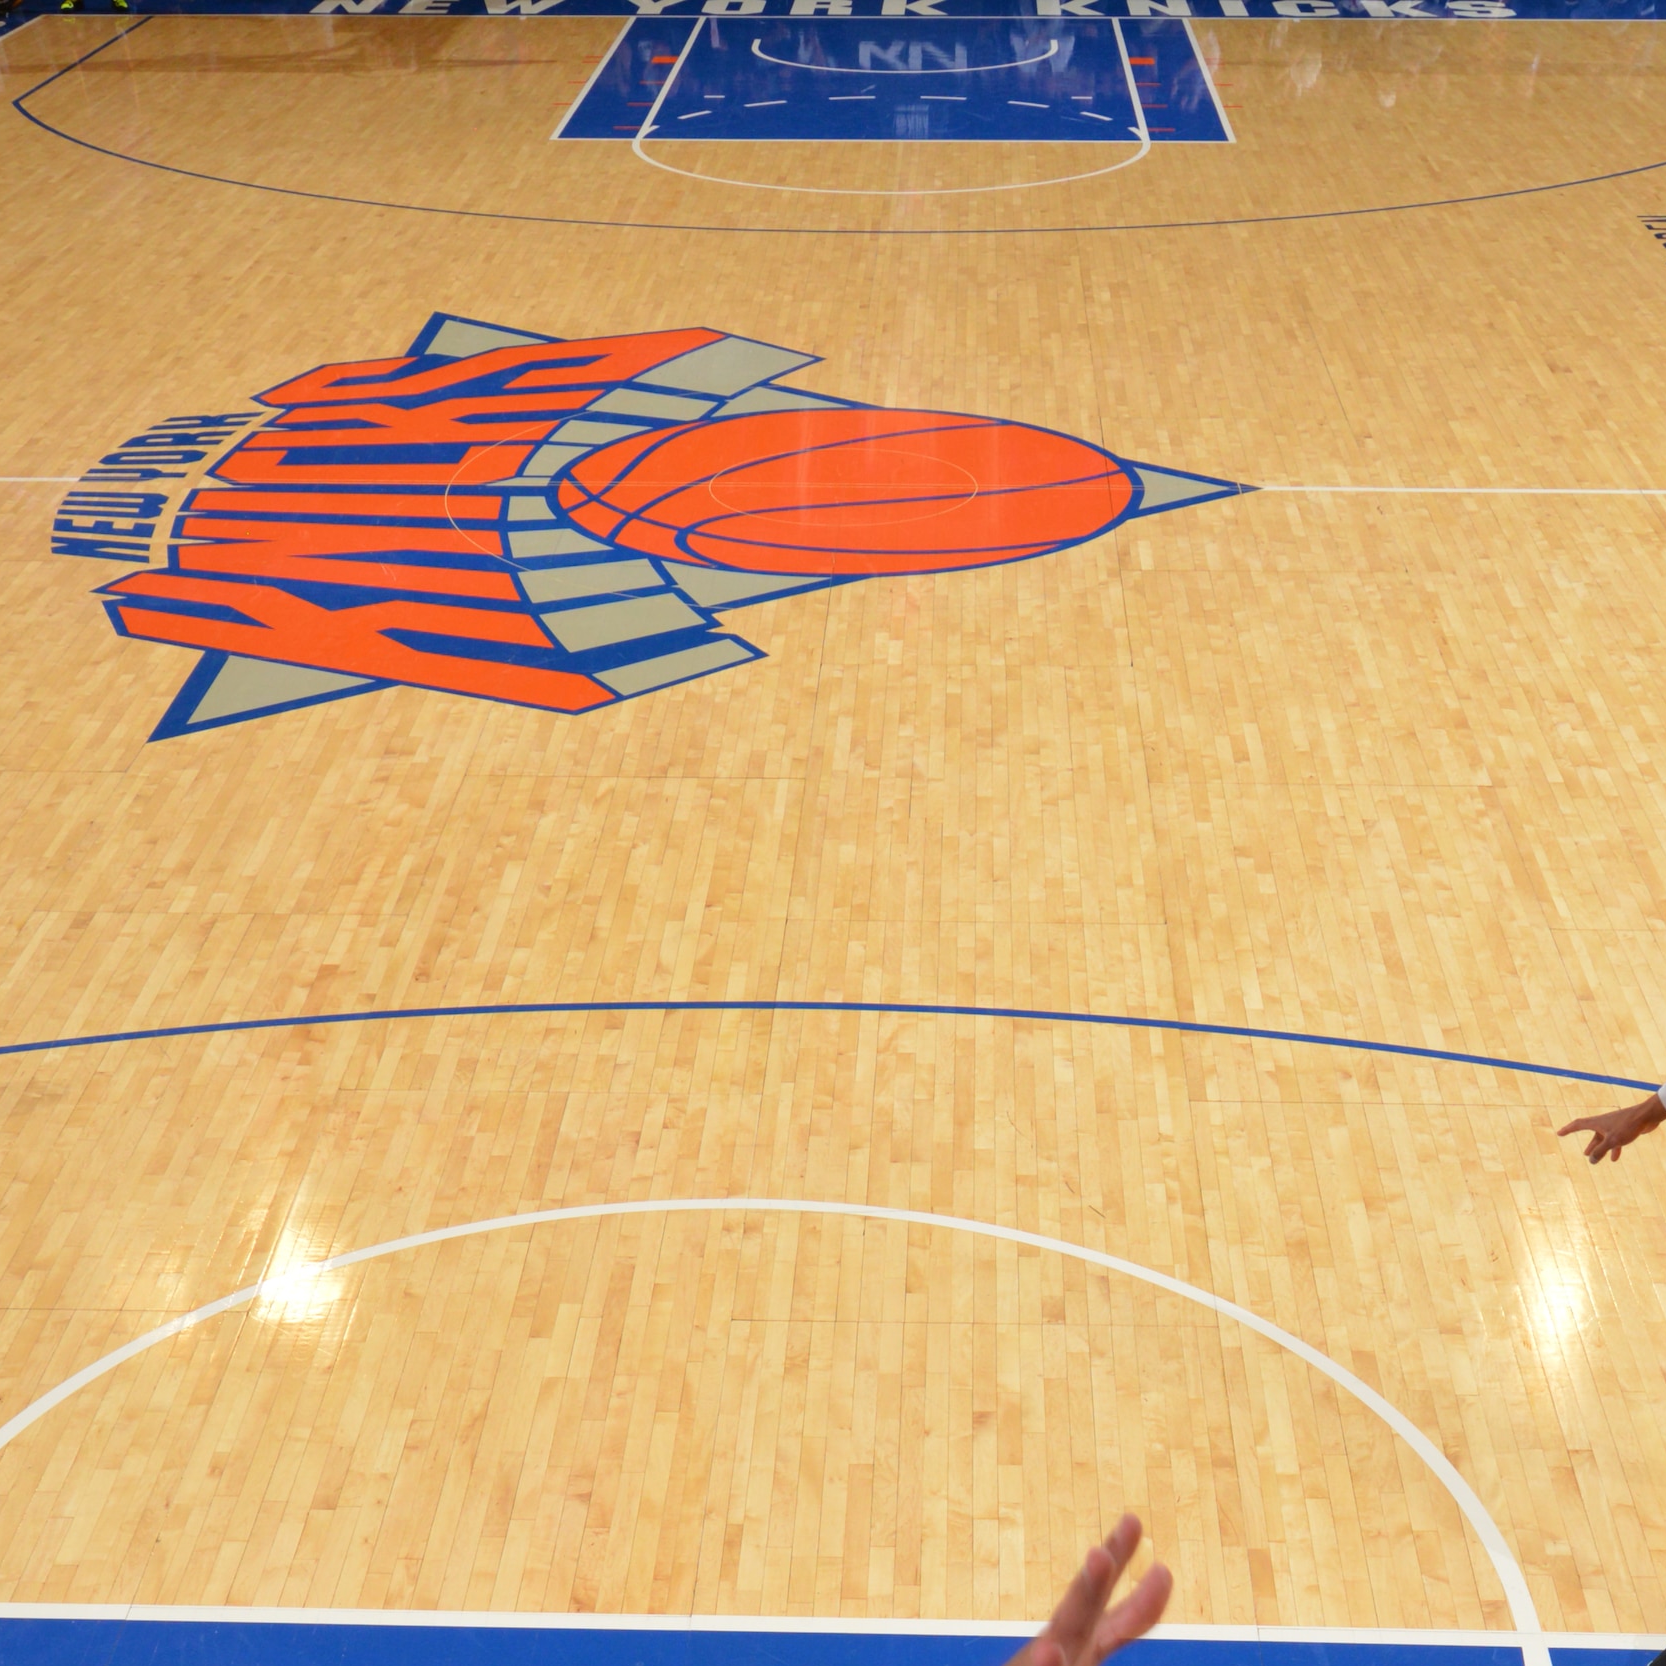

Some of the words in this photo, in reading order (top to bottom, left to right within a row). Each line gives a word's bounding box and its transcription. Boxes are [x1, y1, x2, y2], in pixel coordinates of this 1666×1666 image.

[310, 0, 568, 15] NEW
[628, 0, 945, 16] YORK
[1037, 0, 1517, 18] KNICKS
[78, 411, 267, 482] YORK
[50, 491, 170, 564] NEW
[90, 326, 733, 715] KNICKS
